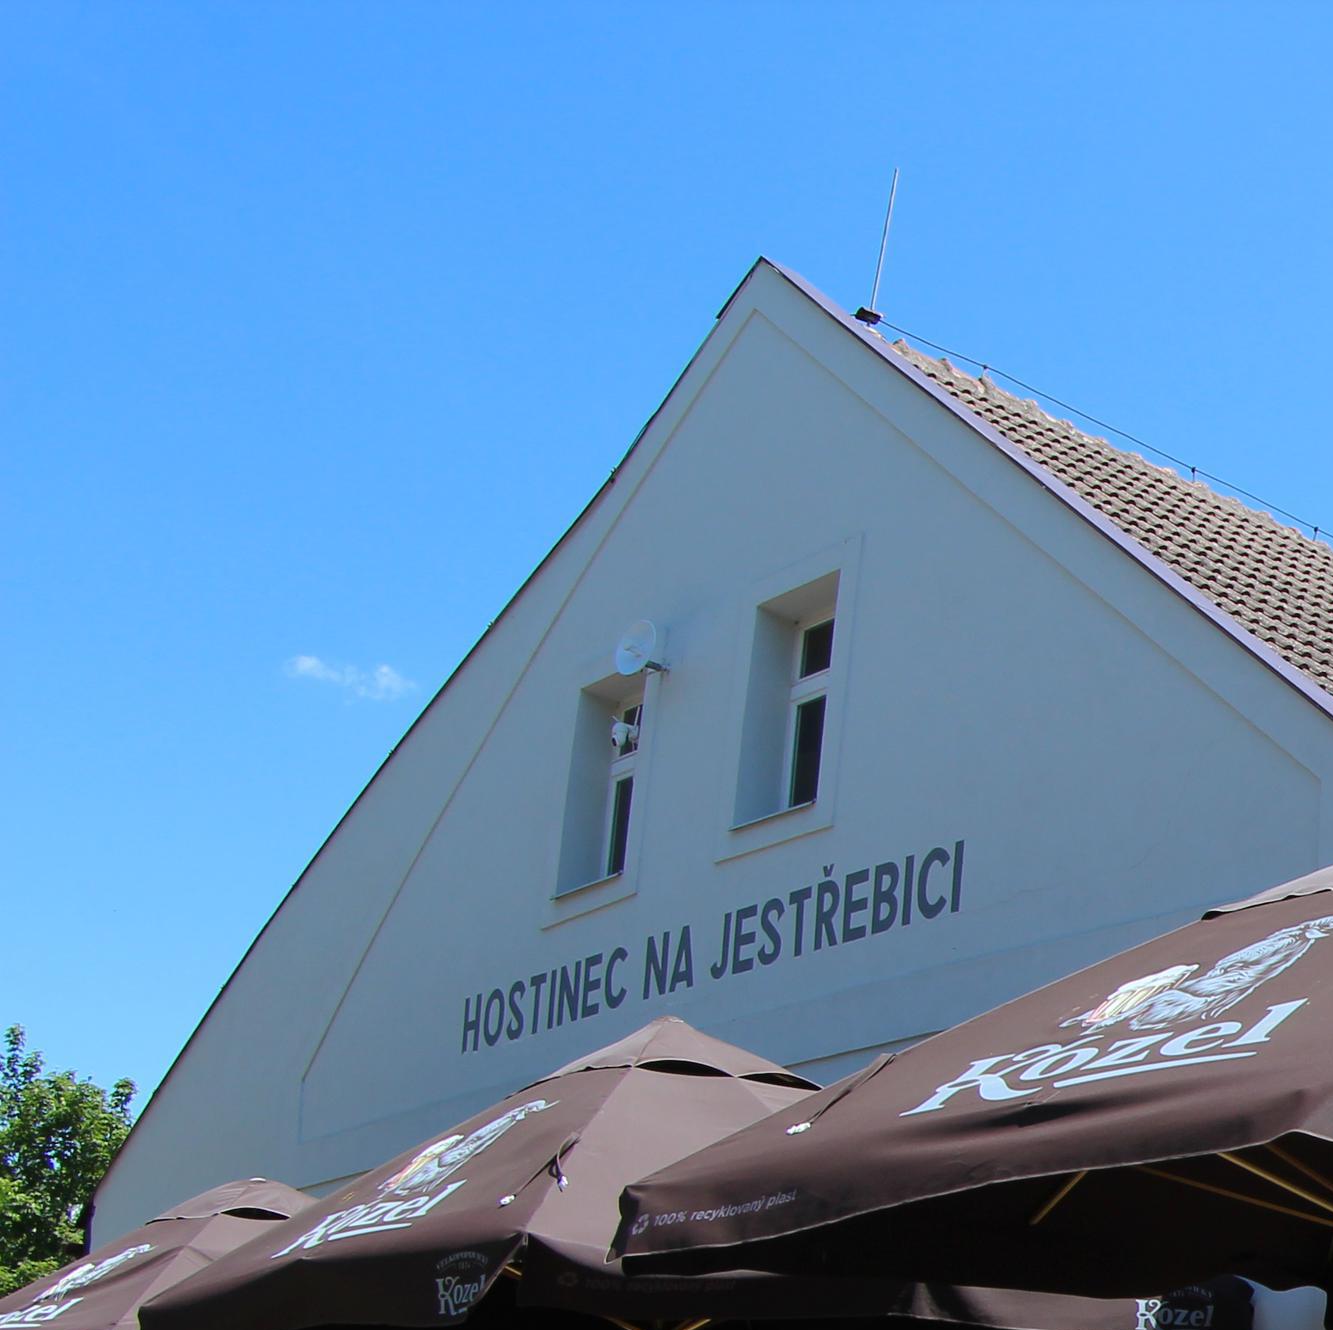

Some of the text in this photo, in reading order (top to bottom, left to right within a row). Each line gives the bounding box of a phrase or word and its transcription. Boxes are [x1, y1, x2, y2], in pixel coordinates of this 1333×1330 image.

[461, 839, 965, 1054] HOSTINEC NA JESTŘEBICI
[899, 998, 1309, 1117] Kozel
[271, 1179, 467, 1260] Kozel
[654, 1189, 797, 1227] 100% recyklovaný plast
